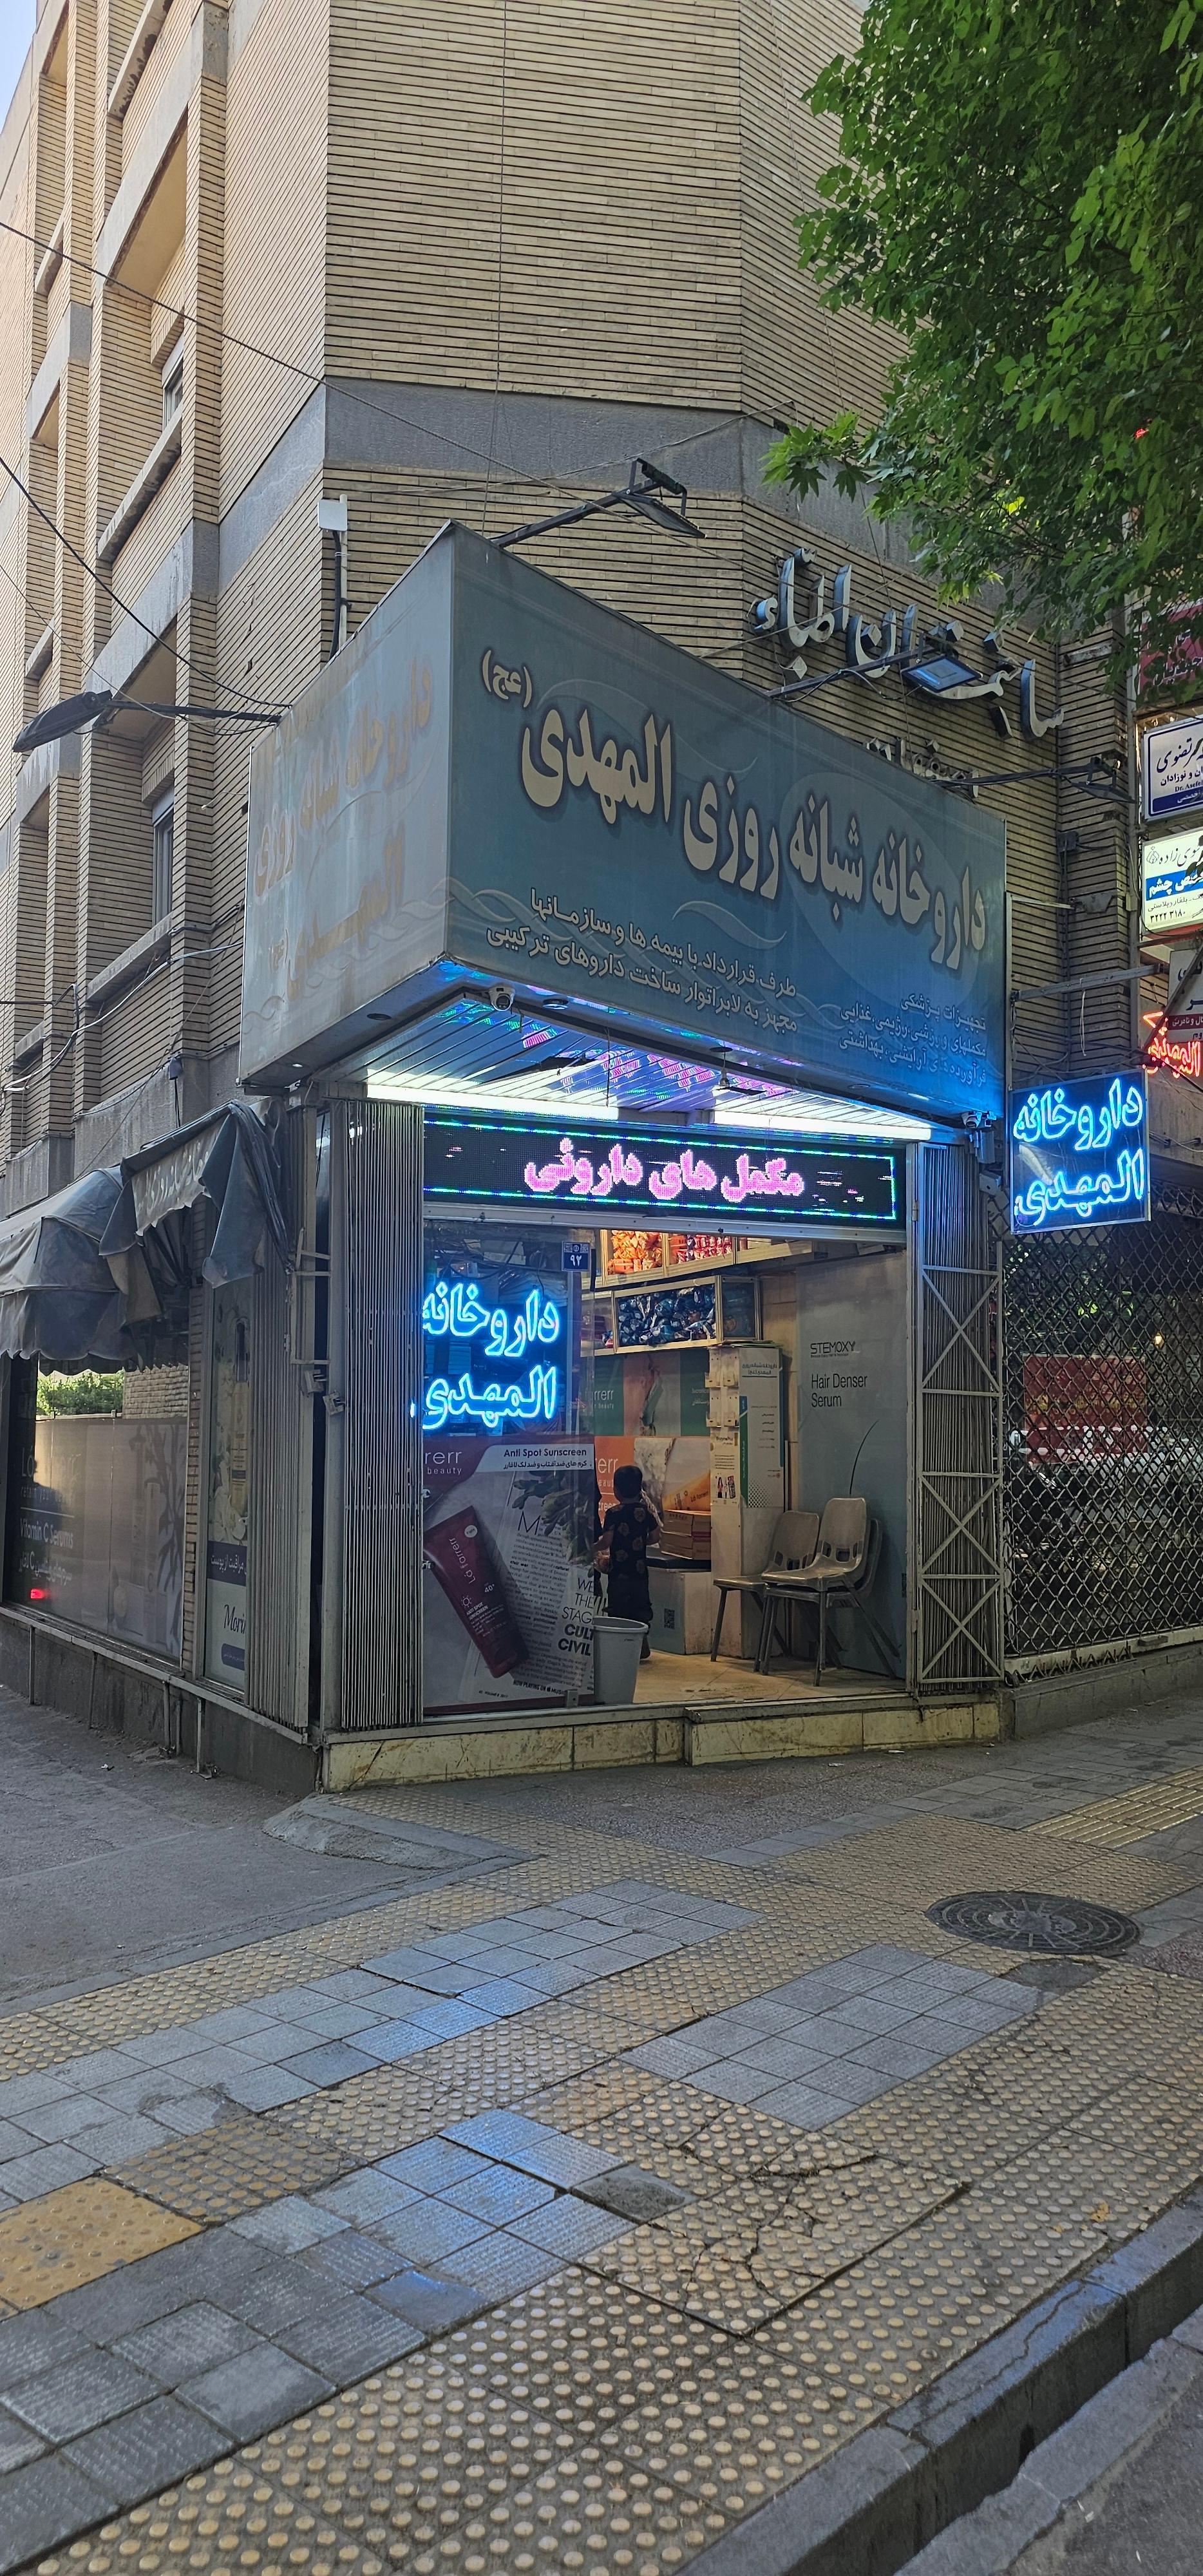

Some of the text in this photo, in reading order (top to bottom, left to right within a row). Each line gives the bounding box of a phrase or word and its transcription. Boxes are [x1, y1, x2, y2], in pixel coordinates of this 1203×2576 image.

[846, 603, 1065, 741] ساختان
[1157, 737, 1202, 773] رتضوی
[1160, 770, 1186, 786] نوزادان
[482, 650, 986, 970] داروخانه شبانه روزی المهدی (عج)
[1149, 878, 1173, 898] چشم
[615, 926, 625, 945] و
[629, 923, 646, 948] ها
[651, 934, 684, 965] بیمه
[688, 943, 699, 967] با
[486, 925, 797, 1034] مجهز به لابراتوار ساخت داروهای ترکیبی
[703, 951, 755, 985] قرارداد
[759, 971, 796, 998] طرف
[900, 993, 986, 1034] تجهیزات پزشکی
[839, 1030, 884, 1059] بهداشتی
[1013, 1078, 1144, 1151] داروخانه
[649, 1150, 717, 1200] های
[721, 1154, 805, 1203] مکمل
[1014, 1148, 1144, 1226] المهدی
[570, 1255, 582, 1267] ۹۲
[422, 1282, 559, 1357] داروخانه
[810, 1341, 855, 1354] STEMOXY
[811, 1373, 867, 1388] Hair Denser
[422, 1365, 558, 1428] المهدی
[811, 1392, 842, 1408] Serum
[504, 1448, 587, 1458] Anti Spot Sunscreen
[578, 1460, 587, 1469] کرم
[595, 1458, 618, 1473] err
[427, 1466, 462, 1476] beauty
[21, 1518, 73, 1549] Vitamin C Serums
[578, 1577, 594, 1593] WE
[575, 1593, 594, 1609] THE
[558, 1638, 591, 1656] CIVIL
